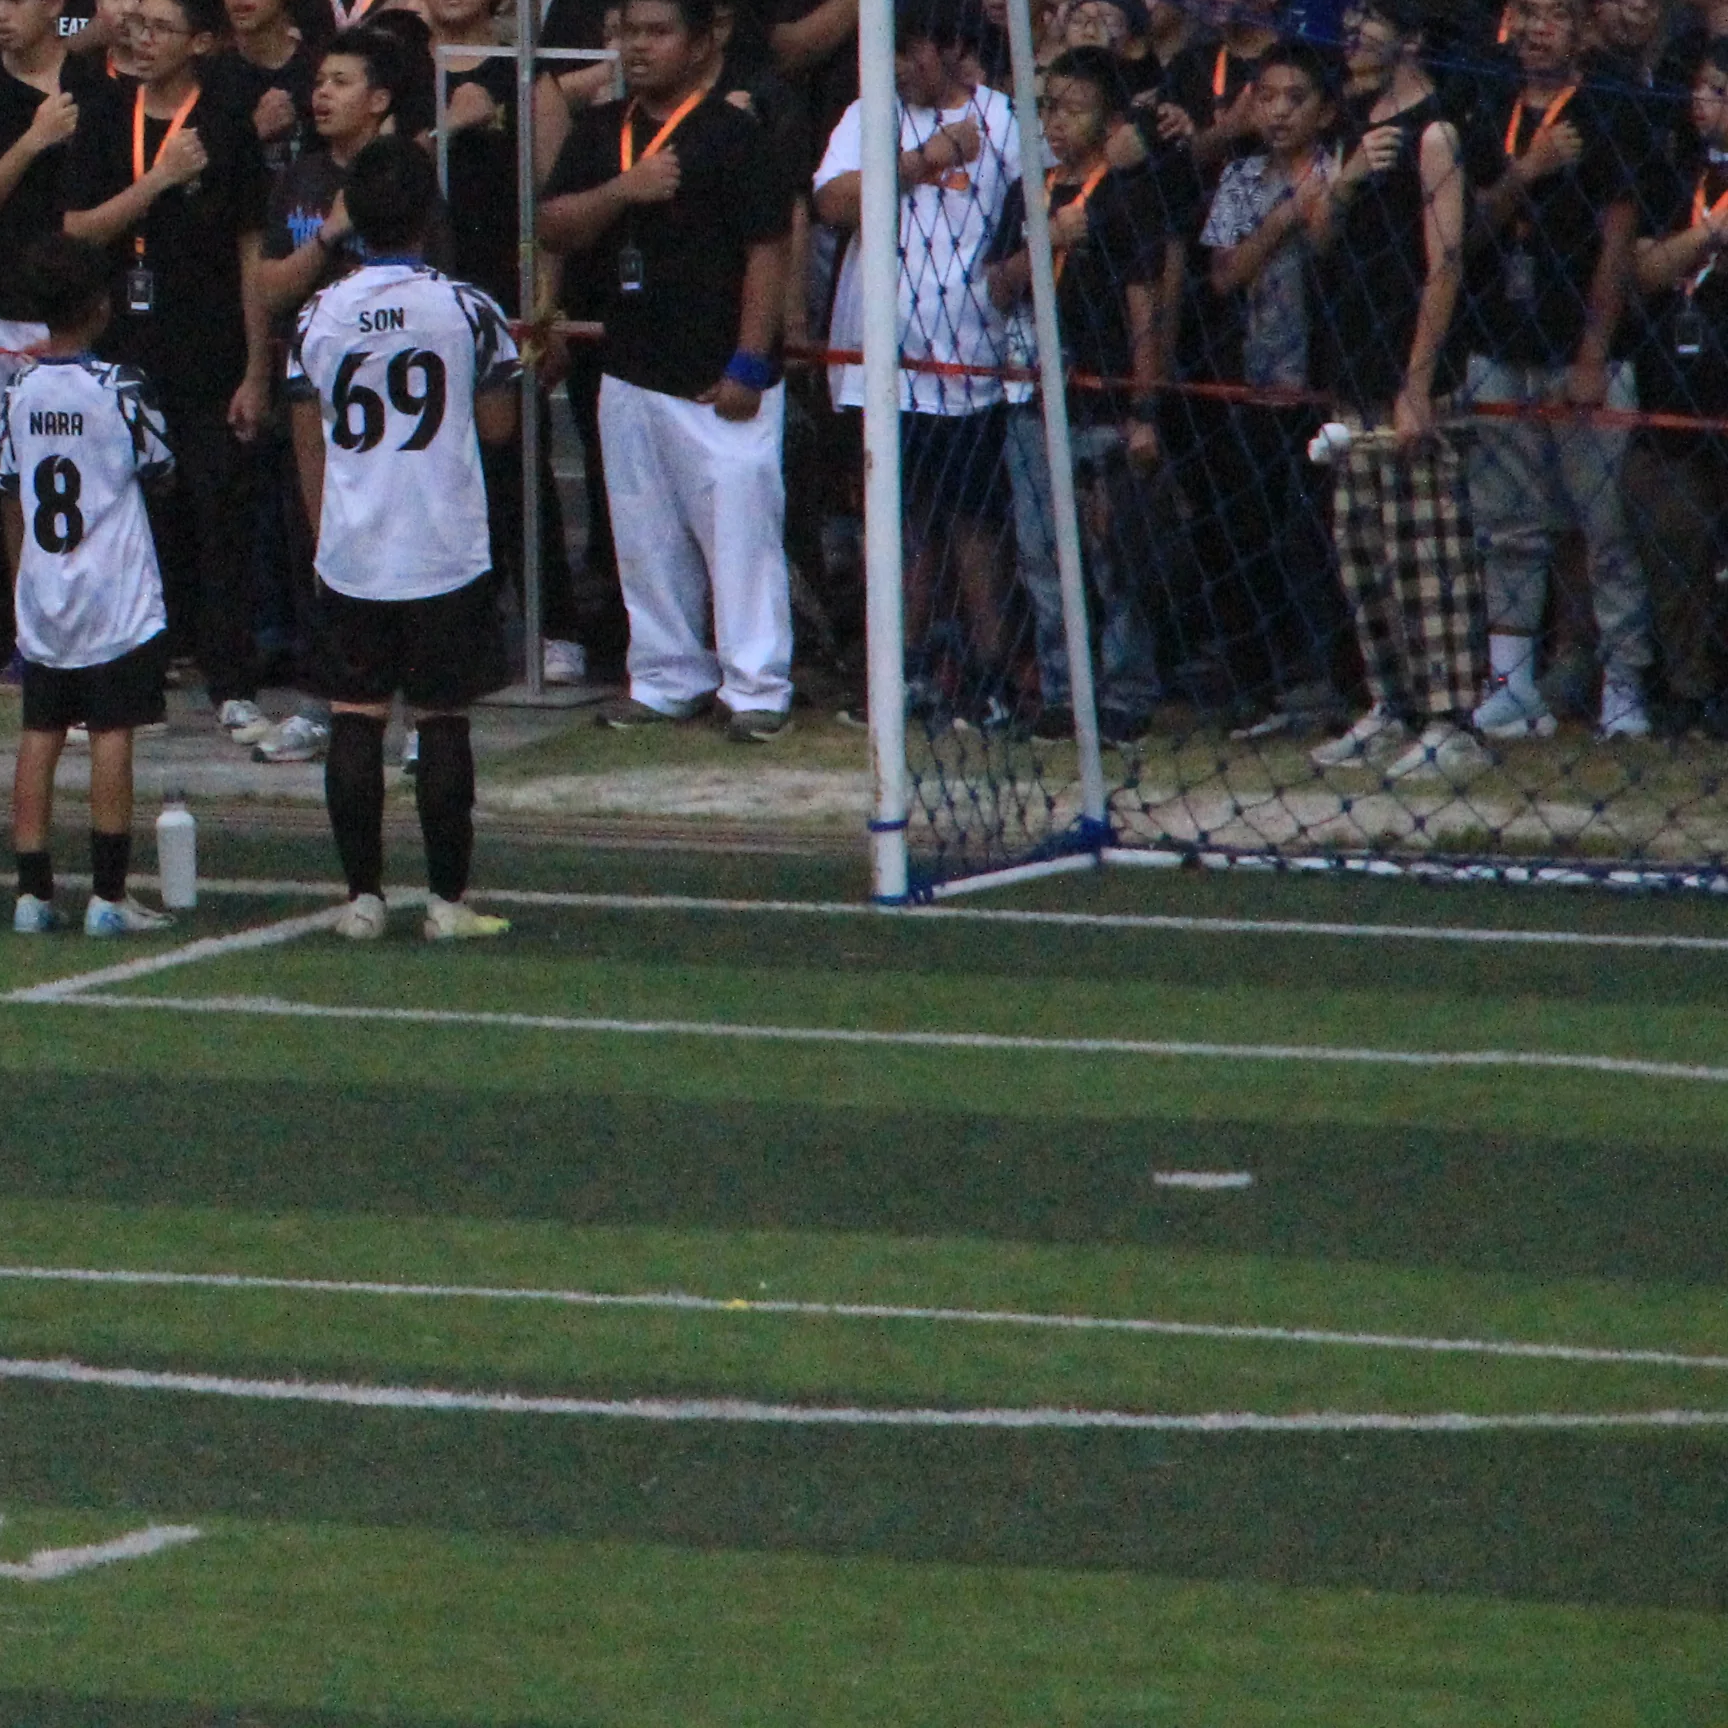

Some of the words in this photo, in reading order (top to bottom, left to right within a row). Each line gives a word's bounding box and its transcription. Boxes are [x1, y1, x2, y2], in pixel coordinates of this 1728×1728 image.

[359, 308, 405, 332] SON
[30, 411, 83, 436] NARA
[332, 348, 446, 453] 69
[33, 454, 84, 554] 8
